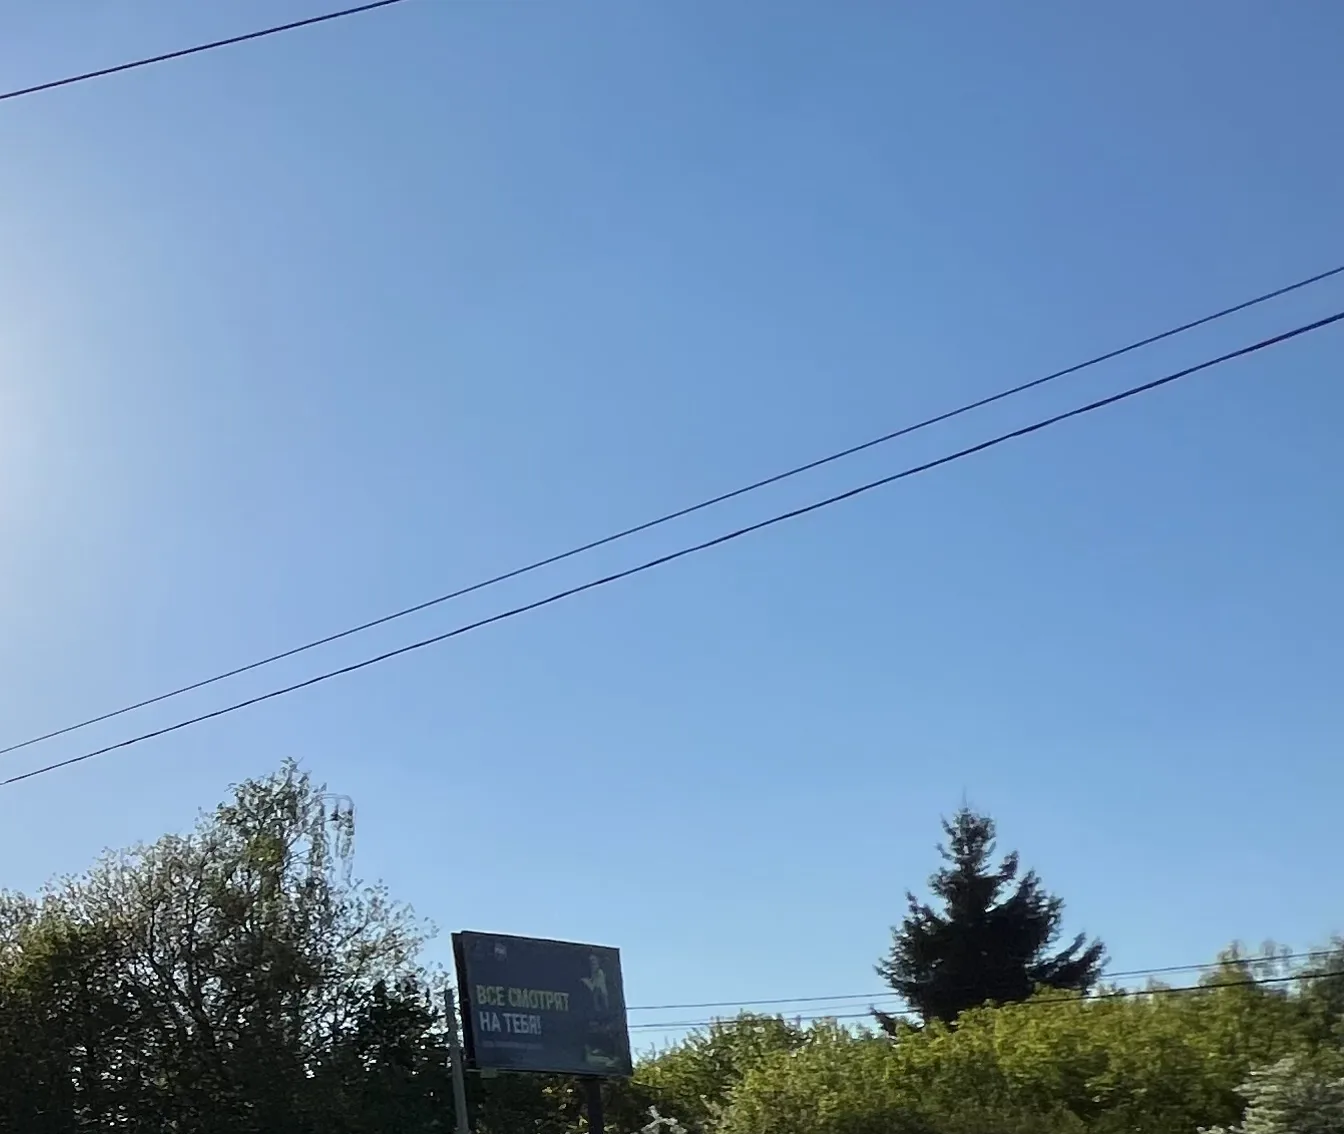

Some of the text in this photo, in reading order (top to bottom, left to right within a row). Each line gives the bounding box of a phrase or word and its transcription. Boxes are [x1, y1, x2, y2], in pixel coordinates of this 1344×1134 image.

[475, 984, 570, 1012] ВСЕ СМОТРЯТ
[479, 1011, 542, 1036] НА ТЕБЯ!
